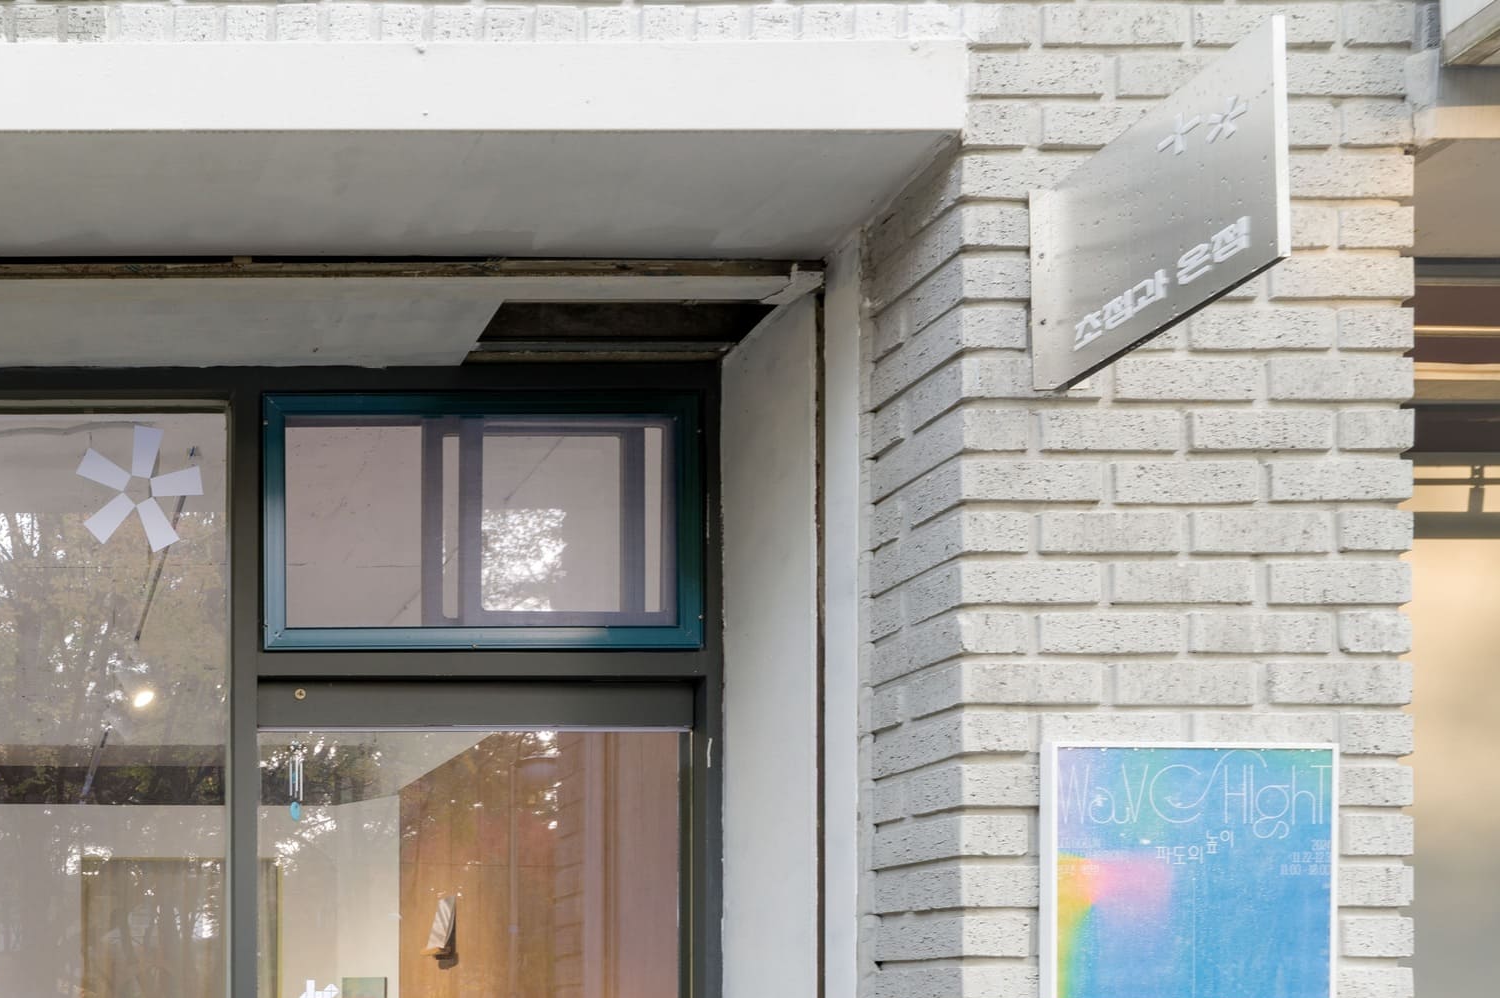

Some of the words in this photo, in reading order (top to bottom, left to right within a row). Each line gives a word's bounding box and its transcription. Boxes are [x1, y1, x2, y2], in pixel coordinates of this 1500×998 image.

[1074, 269, 1170, 351] 초점과
[1177, 215, 1251, 285] 온점
[1155, 845, 1204, 865] 파도의
[1206, 830, 1234, 853] 높이
